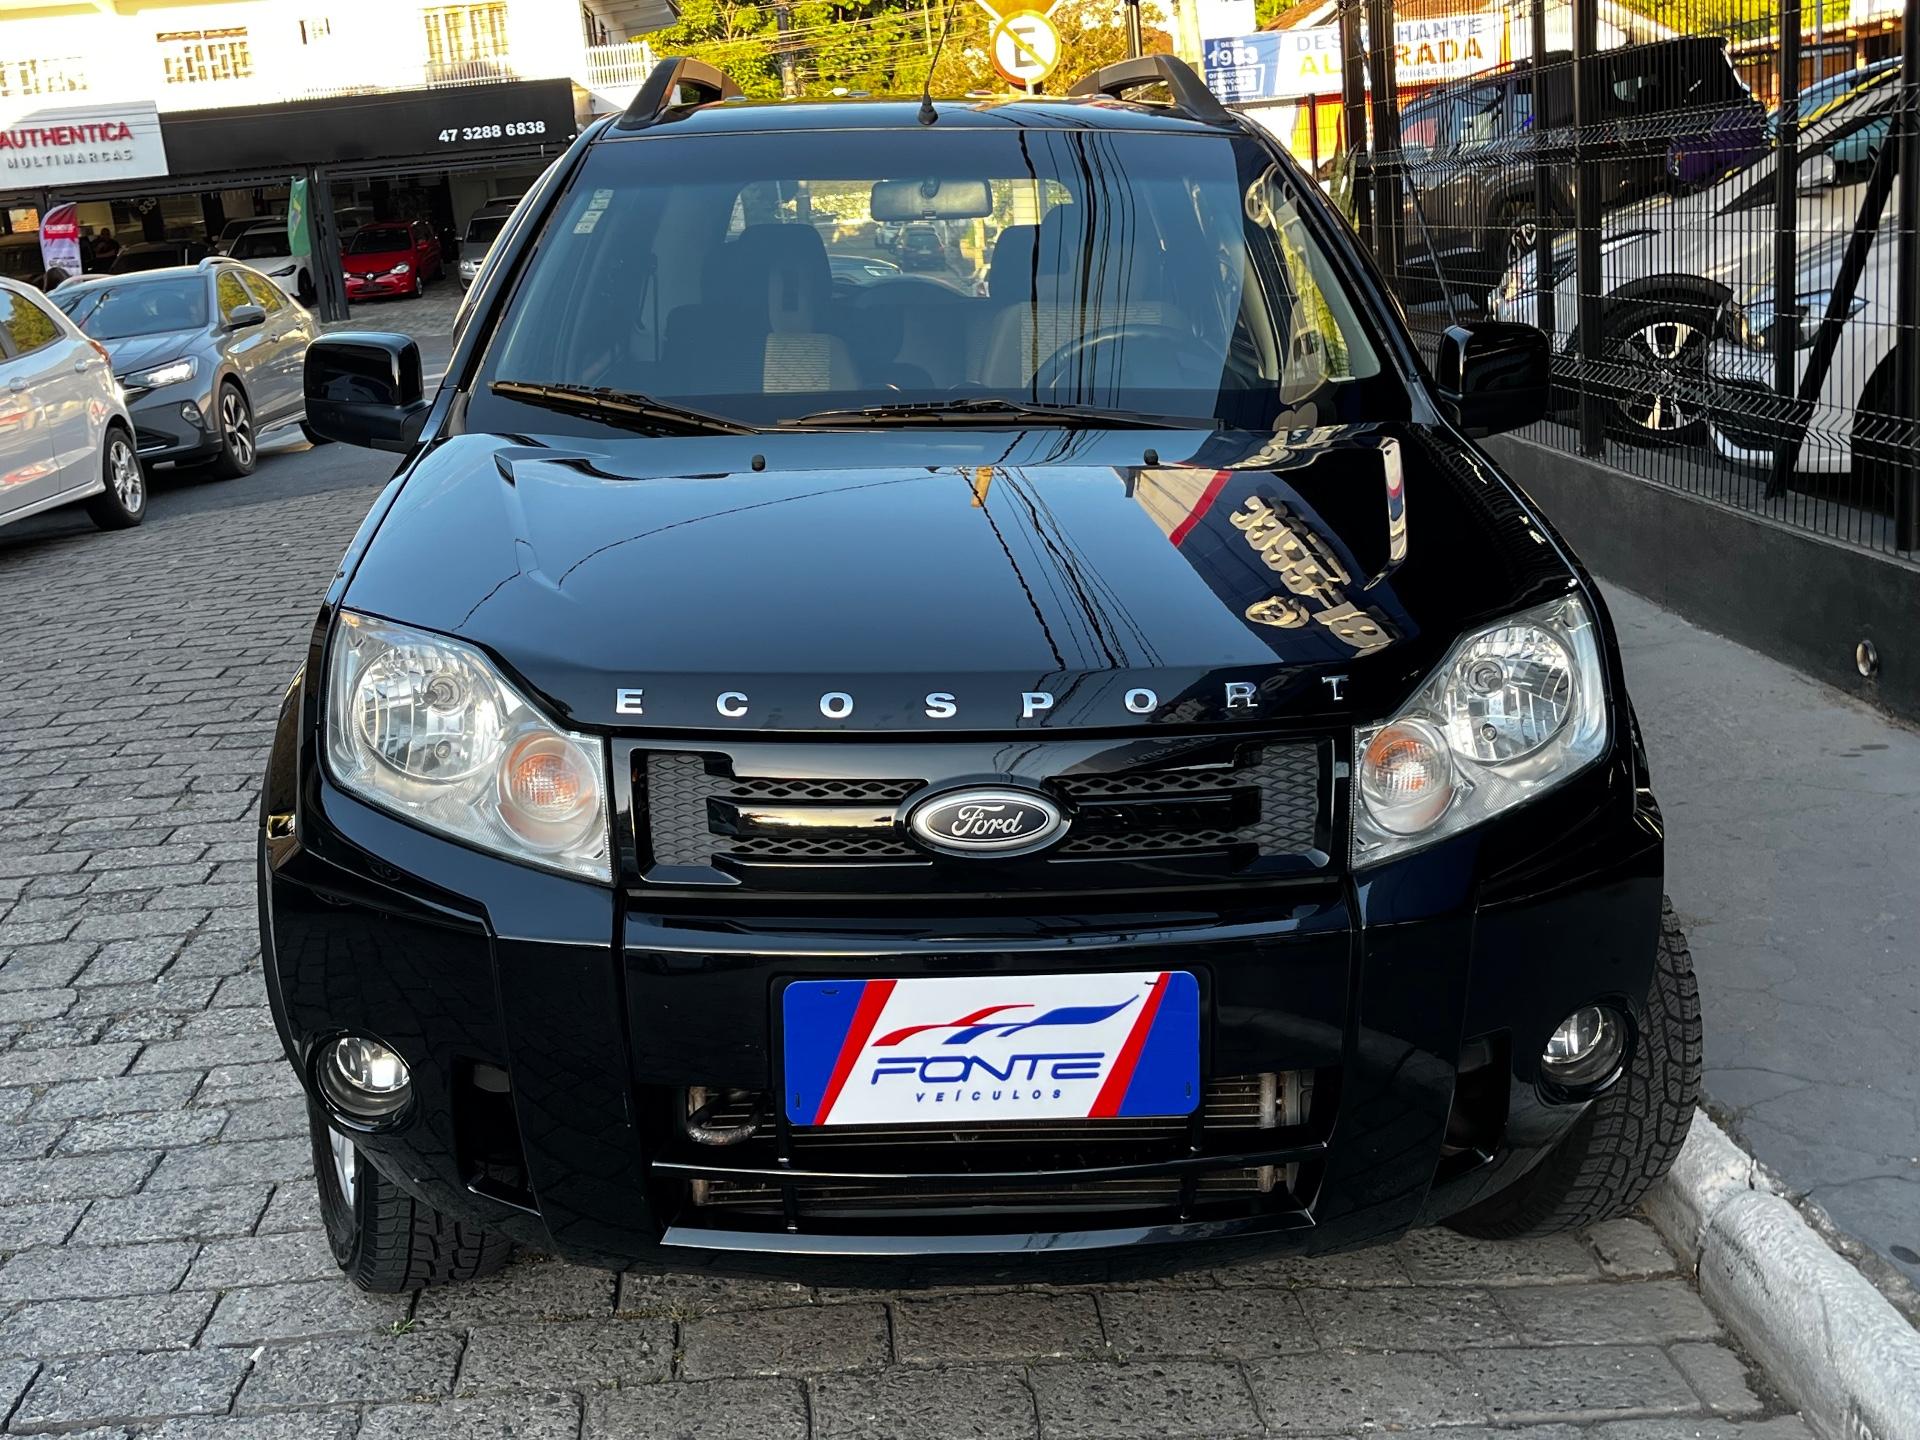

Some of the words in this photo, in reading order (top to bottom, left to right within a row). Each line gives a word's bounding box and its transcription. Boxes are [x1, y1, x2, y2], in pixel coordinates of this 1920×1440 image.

[1012, 26, 1037, 68] E
[1300, 37, 1484, 77] ALRADA
[0, 121, 134, 150] AUTHENTICA
[438, 129, 458, 142] 47
[462, 125, 502, 140] 3288
[505, 121, 546, 136] 6838
[7, 149, 134, 169] MULTIMARCAS
[614, 674, 1350, 719] ECOSPORT
[951, 805, 1024, 836] Ford
[871, 1052, 1105, 1085] FONTE
[915, 1088, 1062, 1103] VEÍCULOS
